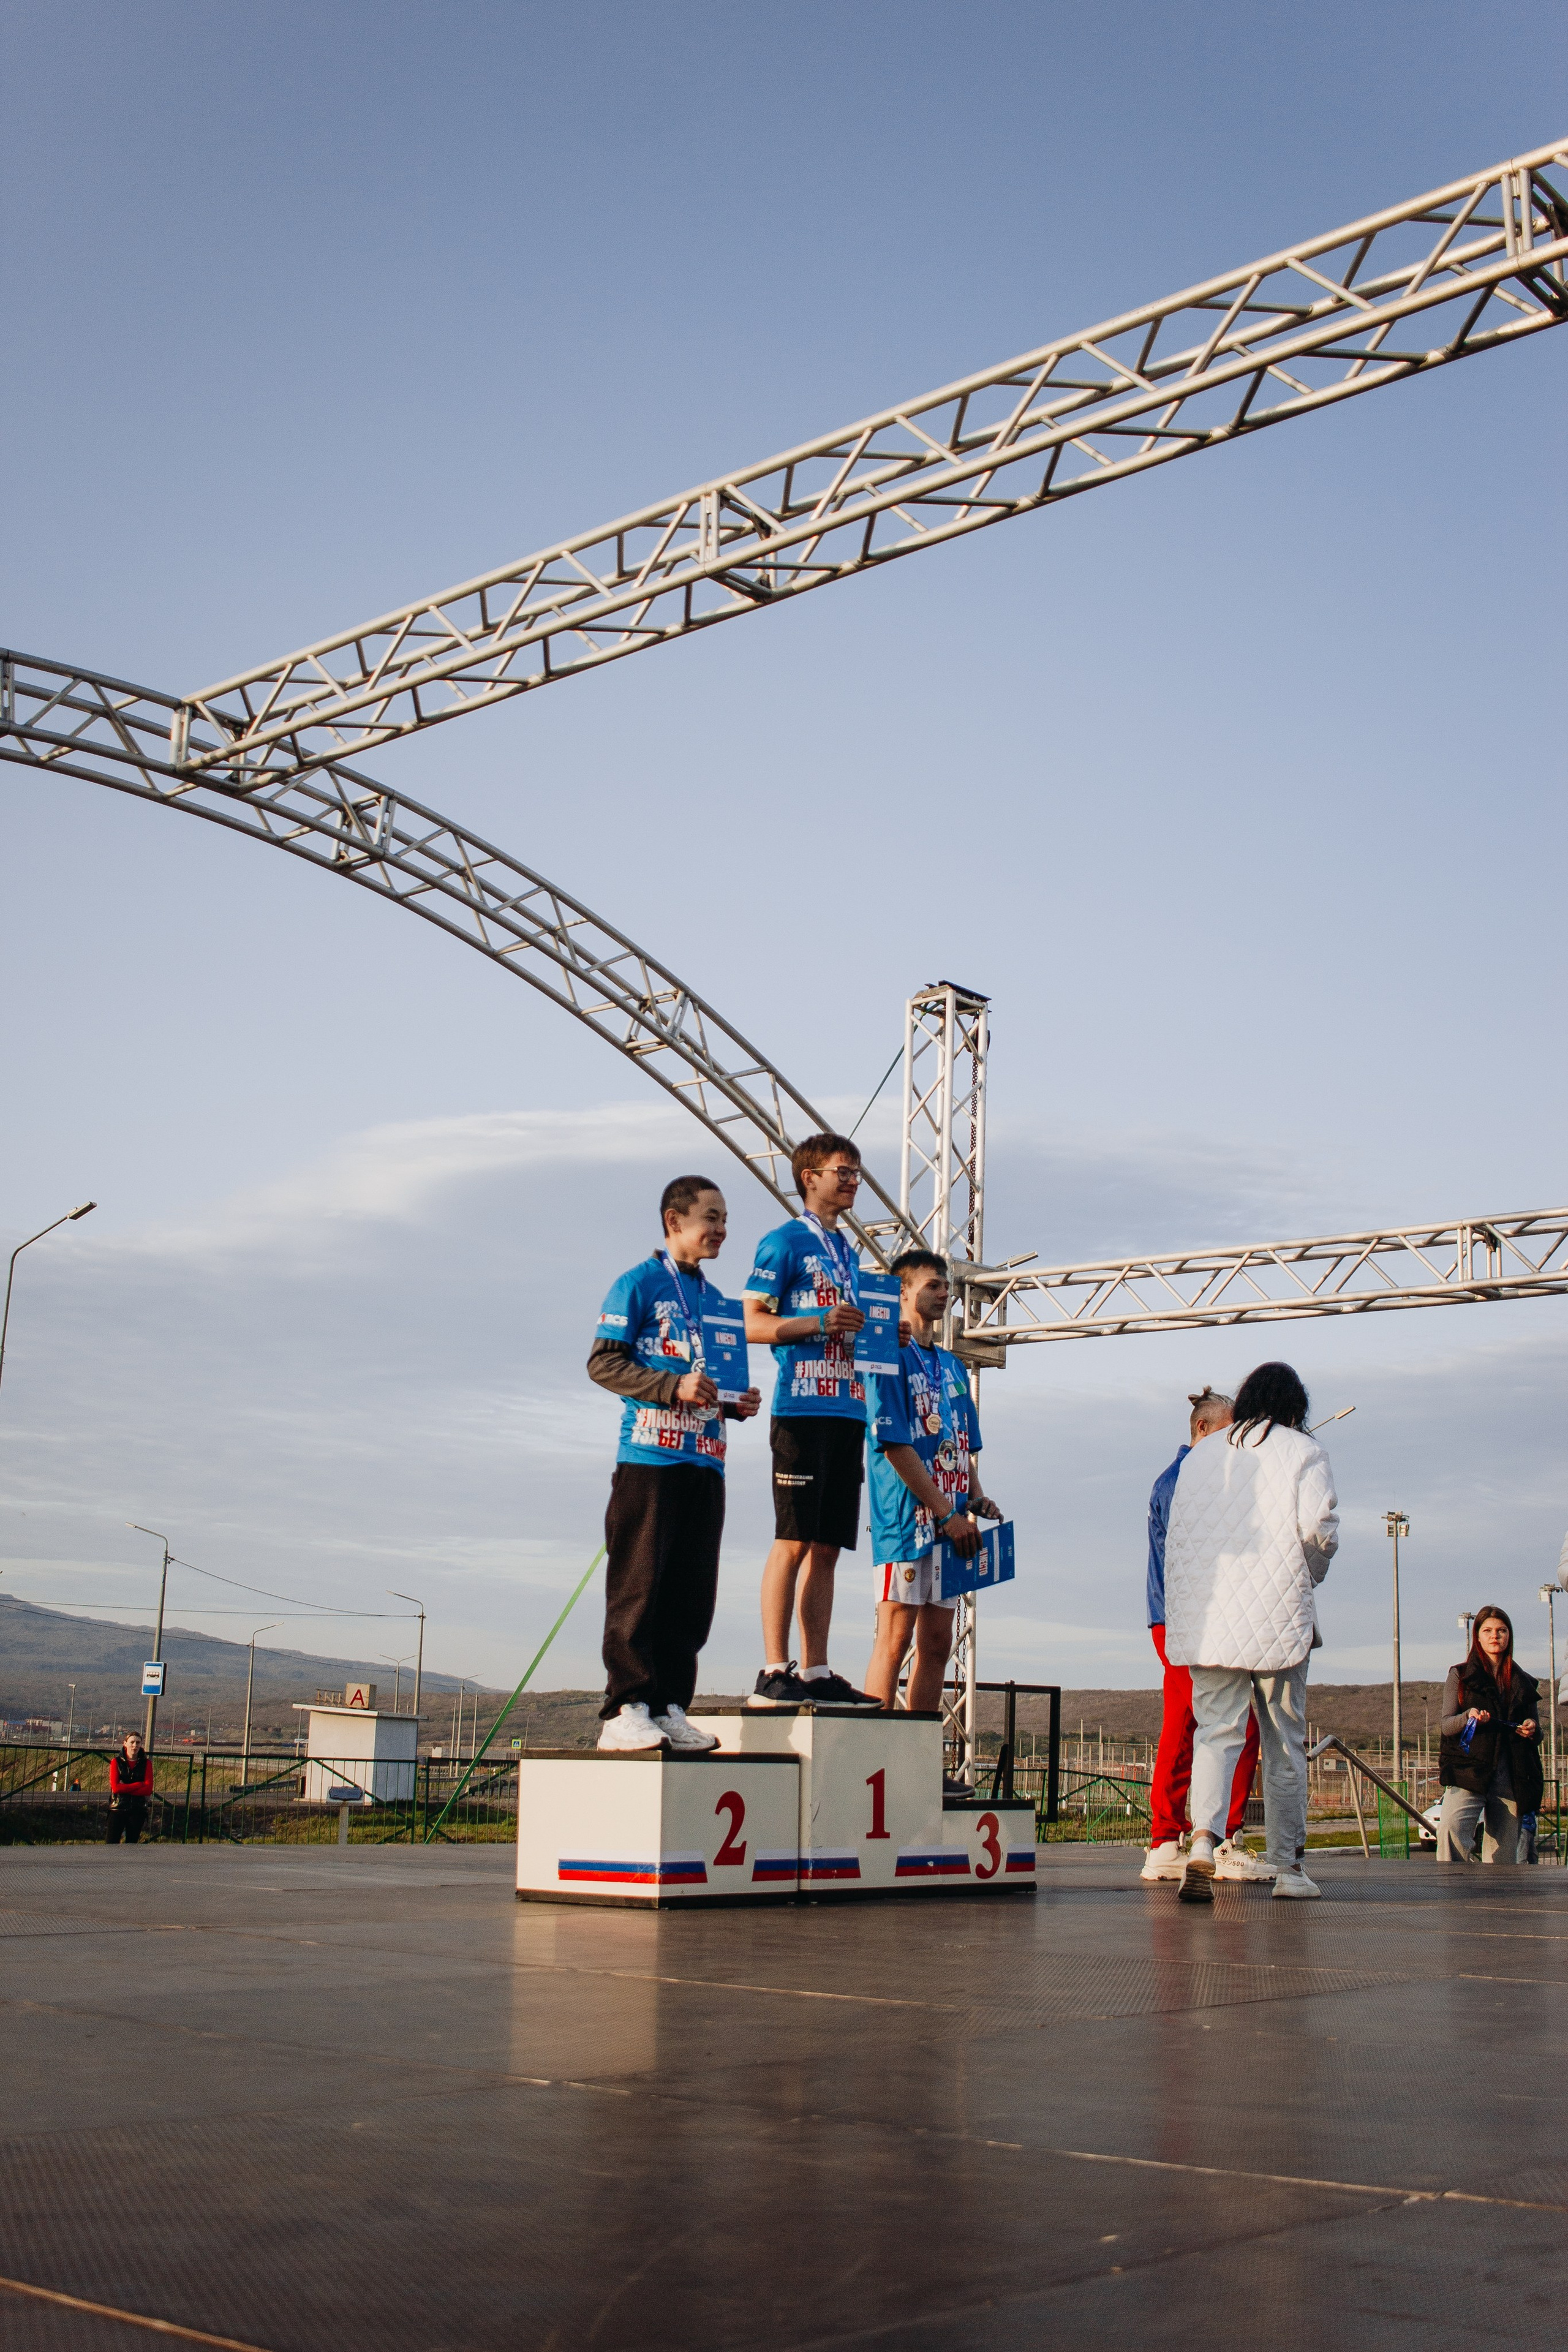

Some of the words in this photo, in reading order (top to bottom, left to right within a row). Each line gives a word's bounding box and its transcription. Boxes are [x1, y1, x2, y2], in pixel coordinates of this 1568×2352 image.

[754, 1267, 777, 1280] ПСБ
[606, 1313, 628, 1327] ПСБ
[795, 1359, 855, 1380] #ЛЮБОВЬ
[791, 1378, 839, 1396] #ЗАБЕГ
[865, 1768, 891, 1839] 1
[713, 1790, 747, 1866] 2
[975, 1811, 1001, 1879] 3
